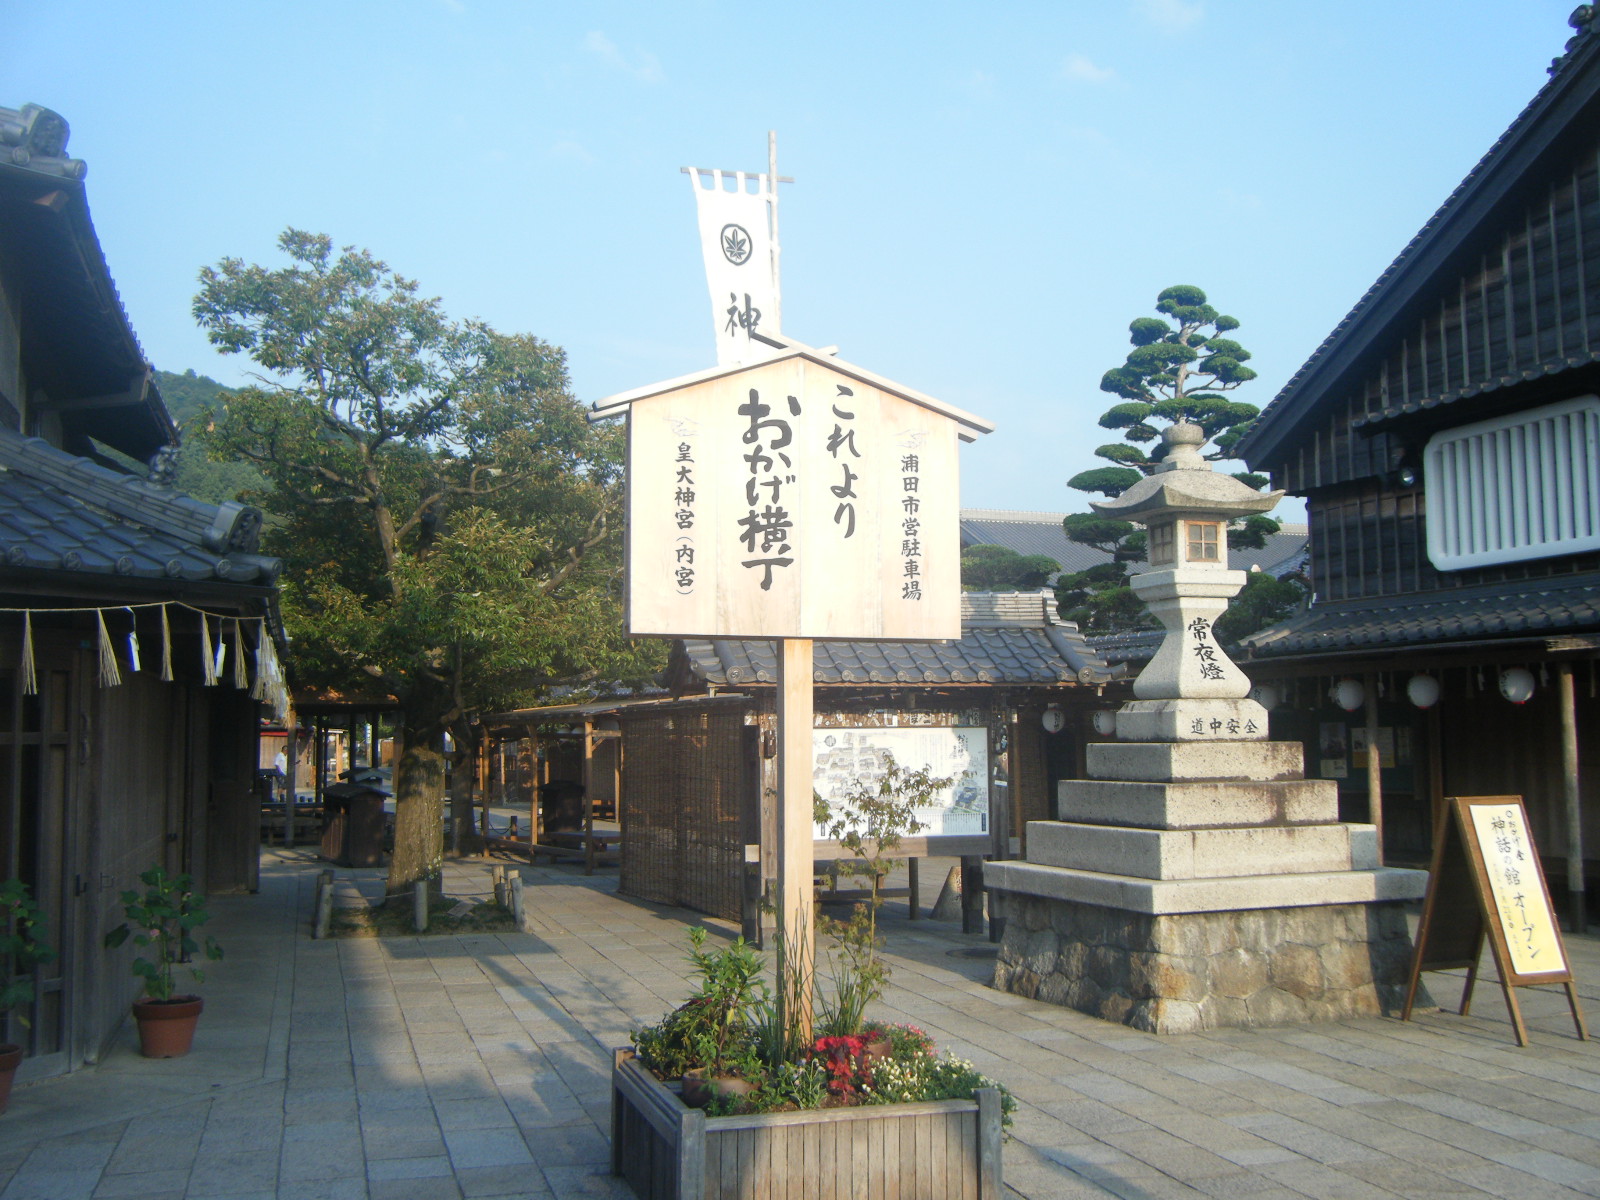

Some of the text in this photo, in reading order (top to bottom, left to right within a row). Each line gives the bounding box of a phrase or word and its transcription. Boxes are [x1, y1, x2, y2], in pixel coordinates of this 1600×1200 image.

[724, 291, 762, 341] 神
[737, 387, 802, 592] おかげ横丁
[825, 383, 862, 539] これより
[899, 453, 923, 601] 浦田市営駐車場
[1187, 616, 1226, 681] 常夜燈
[1190, 717, 1259, 735] 道中安全
